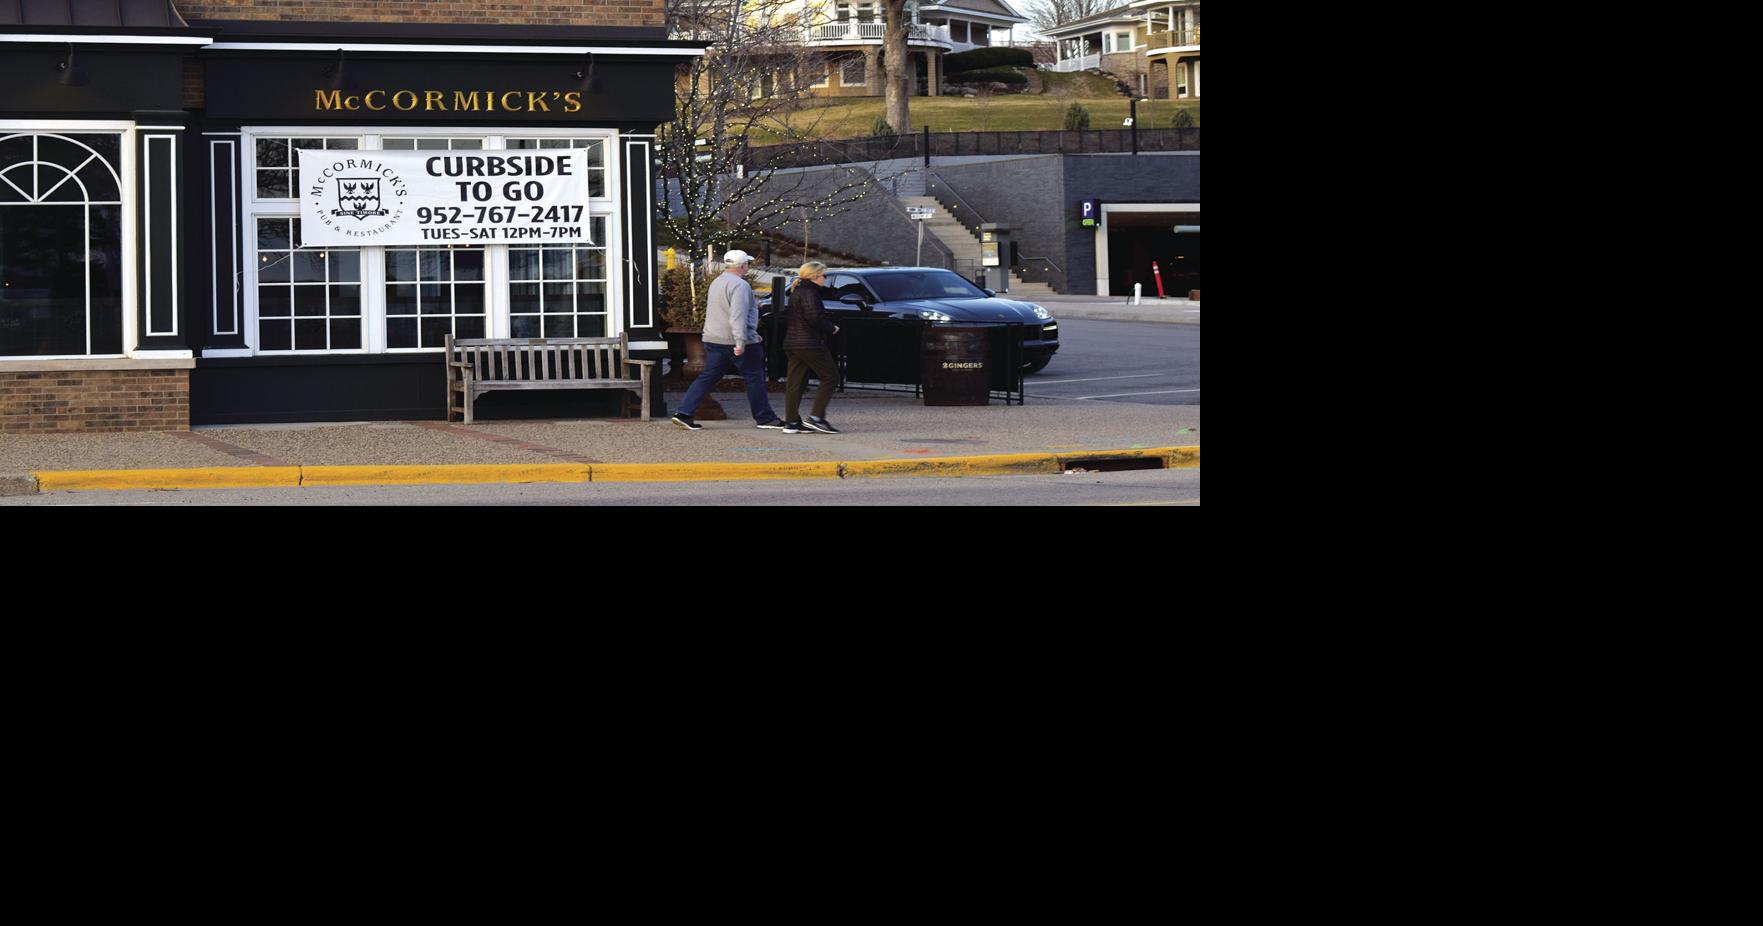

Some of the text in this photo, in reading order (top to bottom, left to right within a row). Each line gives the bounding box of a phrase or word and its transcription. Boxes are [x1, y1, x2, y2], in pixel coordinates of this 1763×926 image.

[314, 89, 582, 113] McCORMICK'S
[426, 156, 572, 177] CURBSIDE
[310, 159, 407, 197] McCORMICK'S
[455, 181, 544, 202] TO GO
[416, 205, 584, 224] 952-767-2417
[1083, 202, 1092, 217] P
[317, 209, 332, 226] PUB
[346, 209, 403, 237] RESTAURANT
[421, 227, 582, 239] TUES-SAT 12PM-7PM
